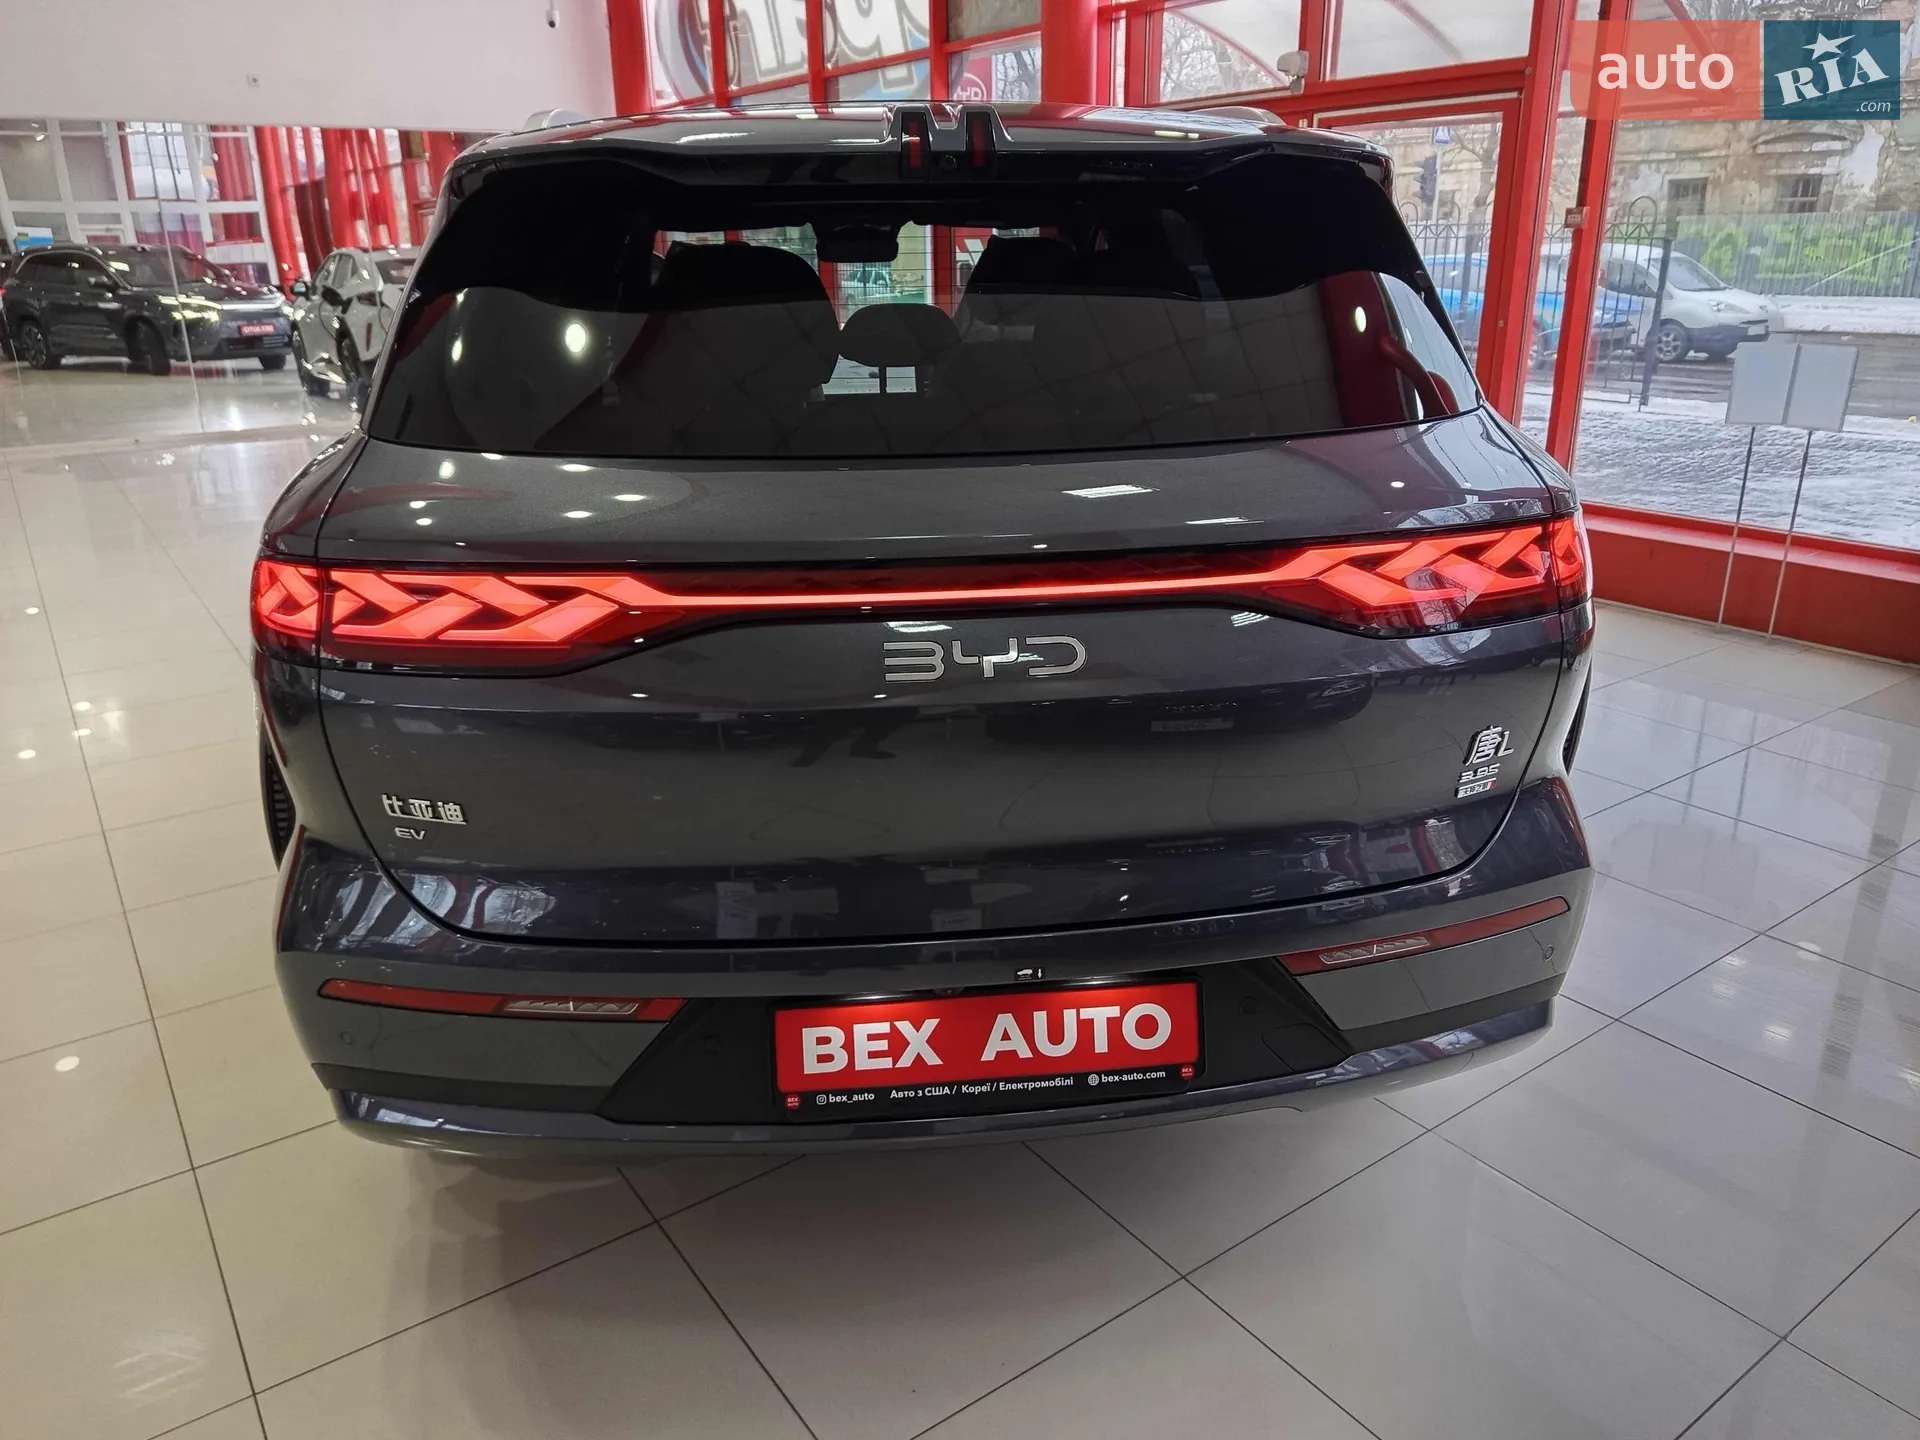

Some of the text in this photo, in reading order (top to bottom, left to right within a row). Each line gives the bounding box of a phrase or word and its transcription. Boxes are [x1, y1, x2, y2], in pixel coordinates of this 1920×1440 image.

[883, 635, 1086, 682] BYD
[381, 794, 467, 825] 比亚迪
[394, 827, 426, 840] EV
[801, 1003, 1172, 1075] BEX AUTO
[1101, 1070, 1166, 1083] bex-auto.com
[829, 1092, 875, 1104] bex_auto
[890, 1090, 915, 1099] Авто
[925, 1086, 951, 1096] США
[961, 1084, 991, 1095] Кореї
[999, 1077, 1074, 1091] Електромобілі
